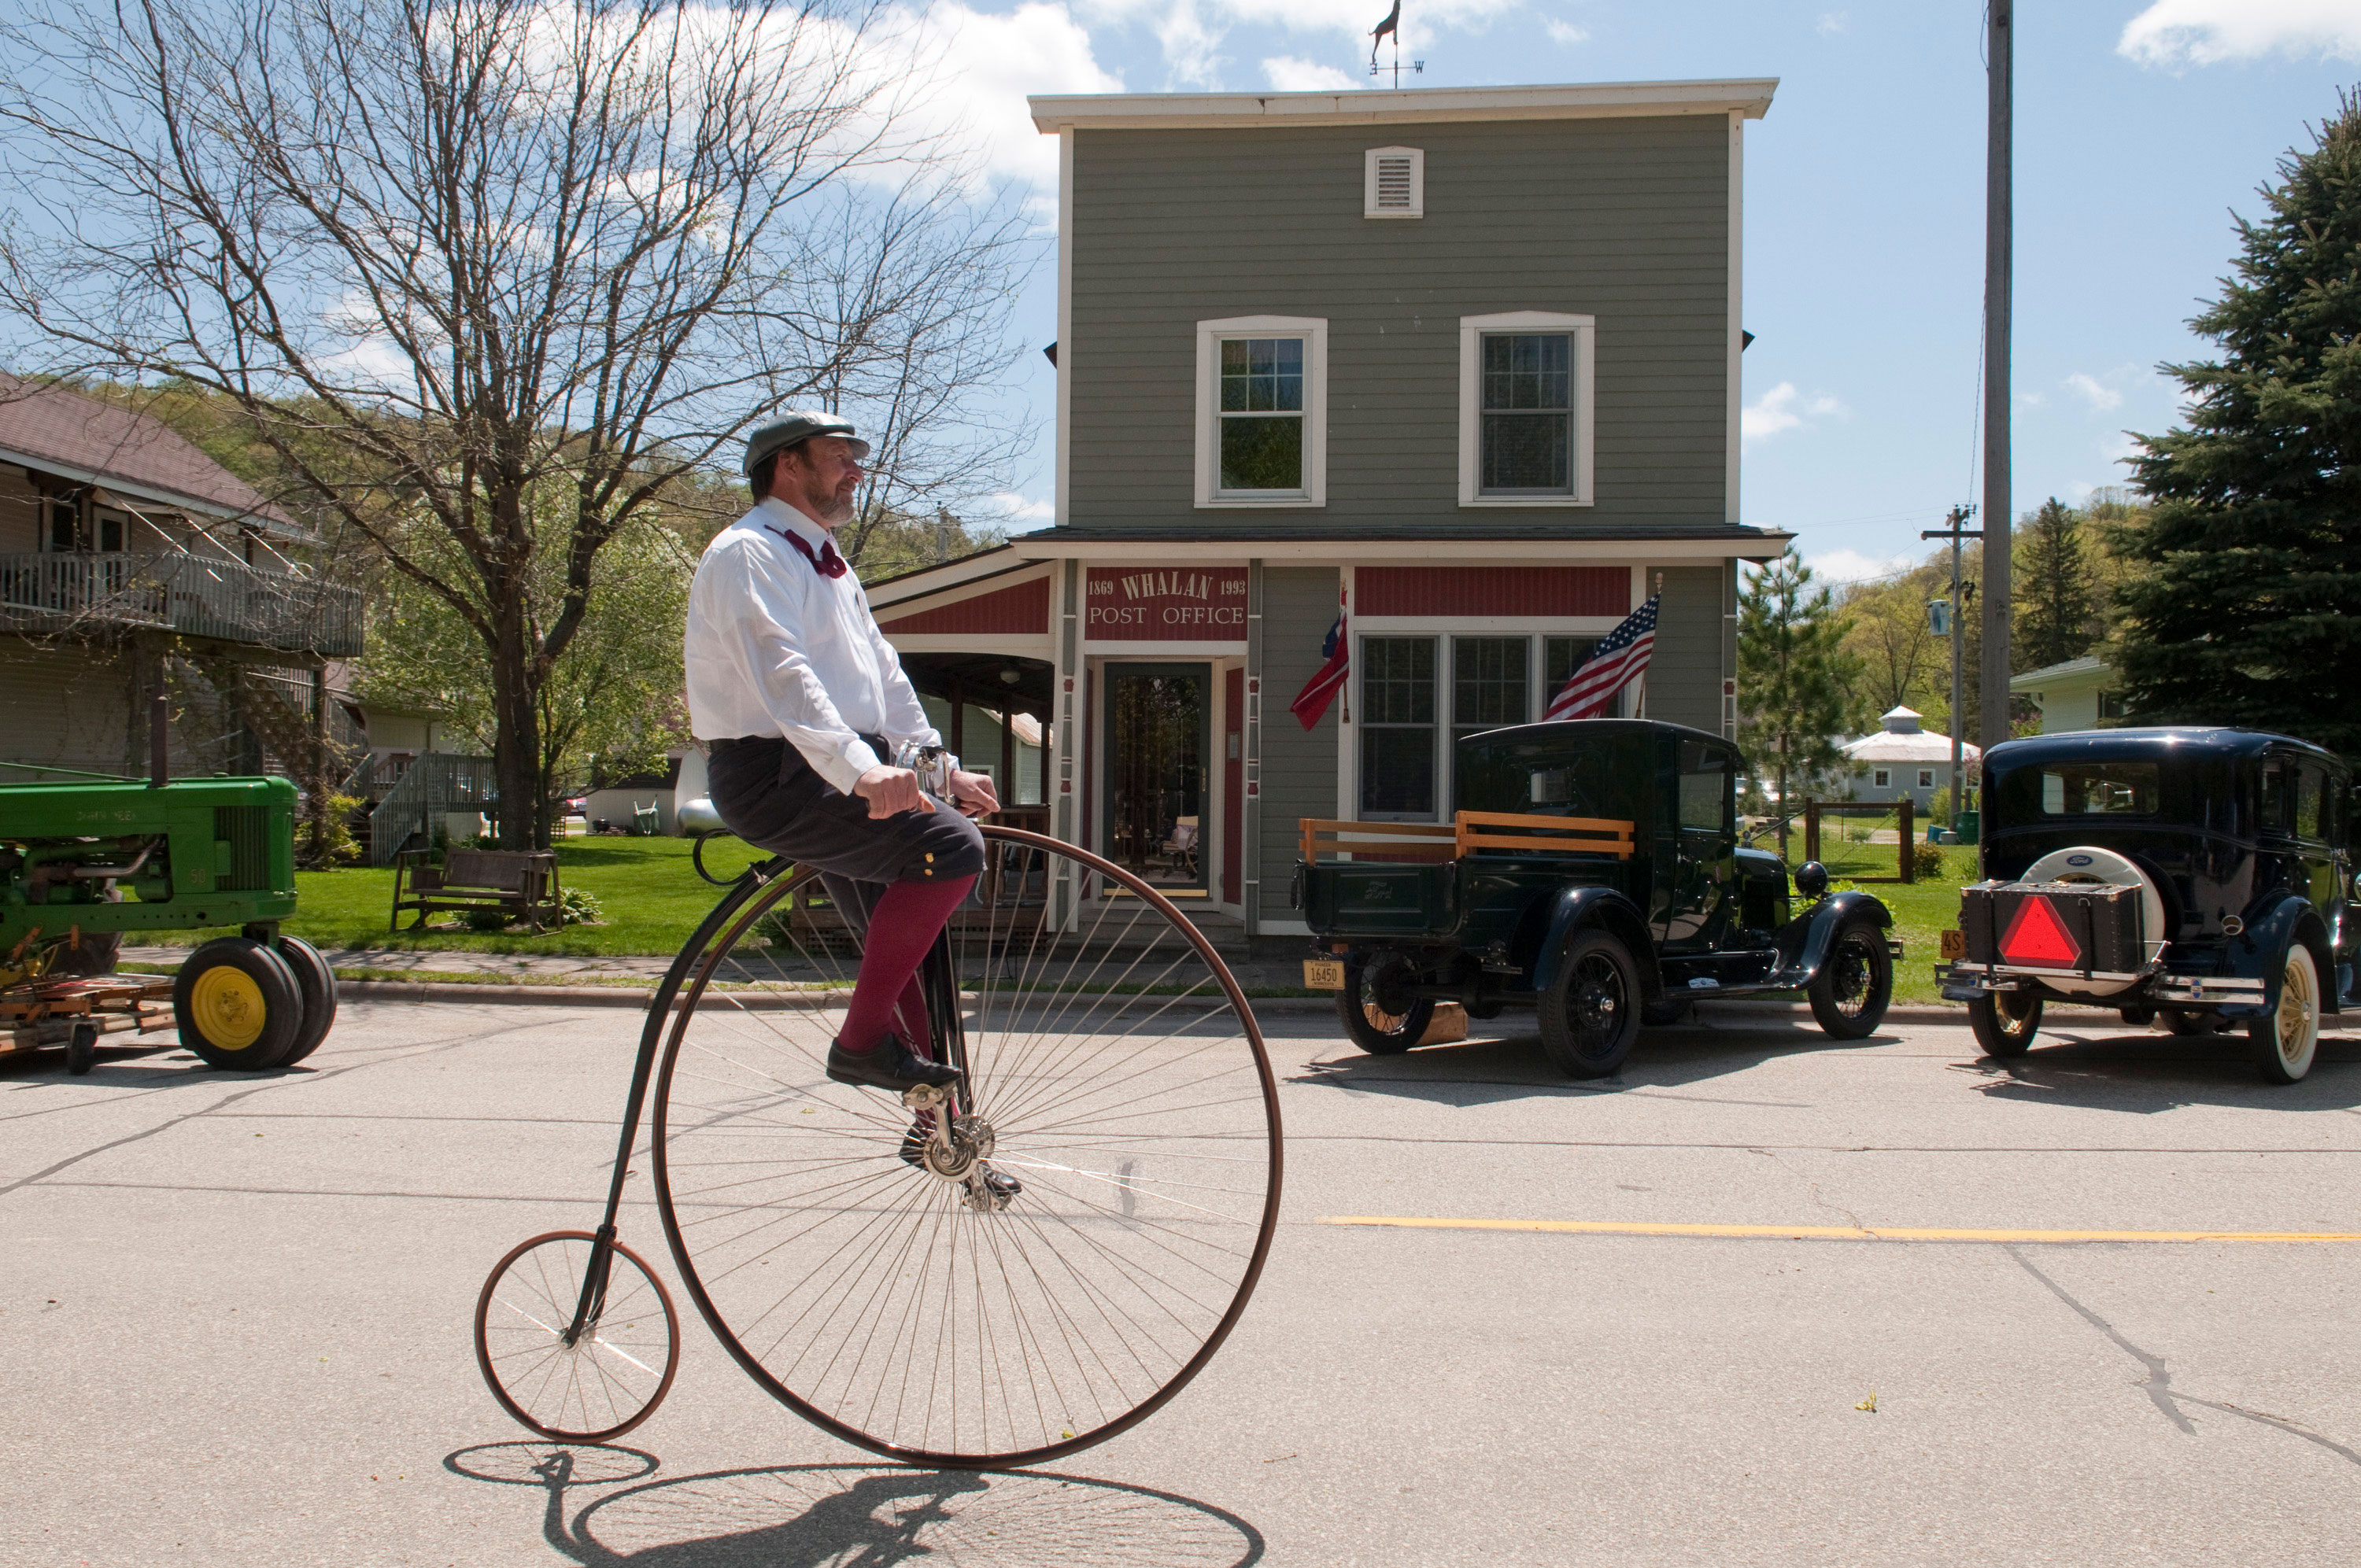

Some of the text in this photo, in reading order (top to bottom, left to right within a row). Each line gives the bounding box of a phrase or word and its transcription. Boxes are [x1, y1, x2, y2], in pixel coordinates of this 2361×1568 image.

[1414, 61, 1424, 74] W
[1088, 571, 1246, 600] 1869 WHALAN 1993
[1089, 607, 1244, 624] POST OFFICE
[1364, 880, 1393, 899] Ford
[1311, 967, 1337, 982] 16450
